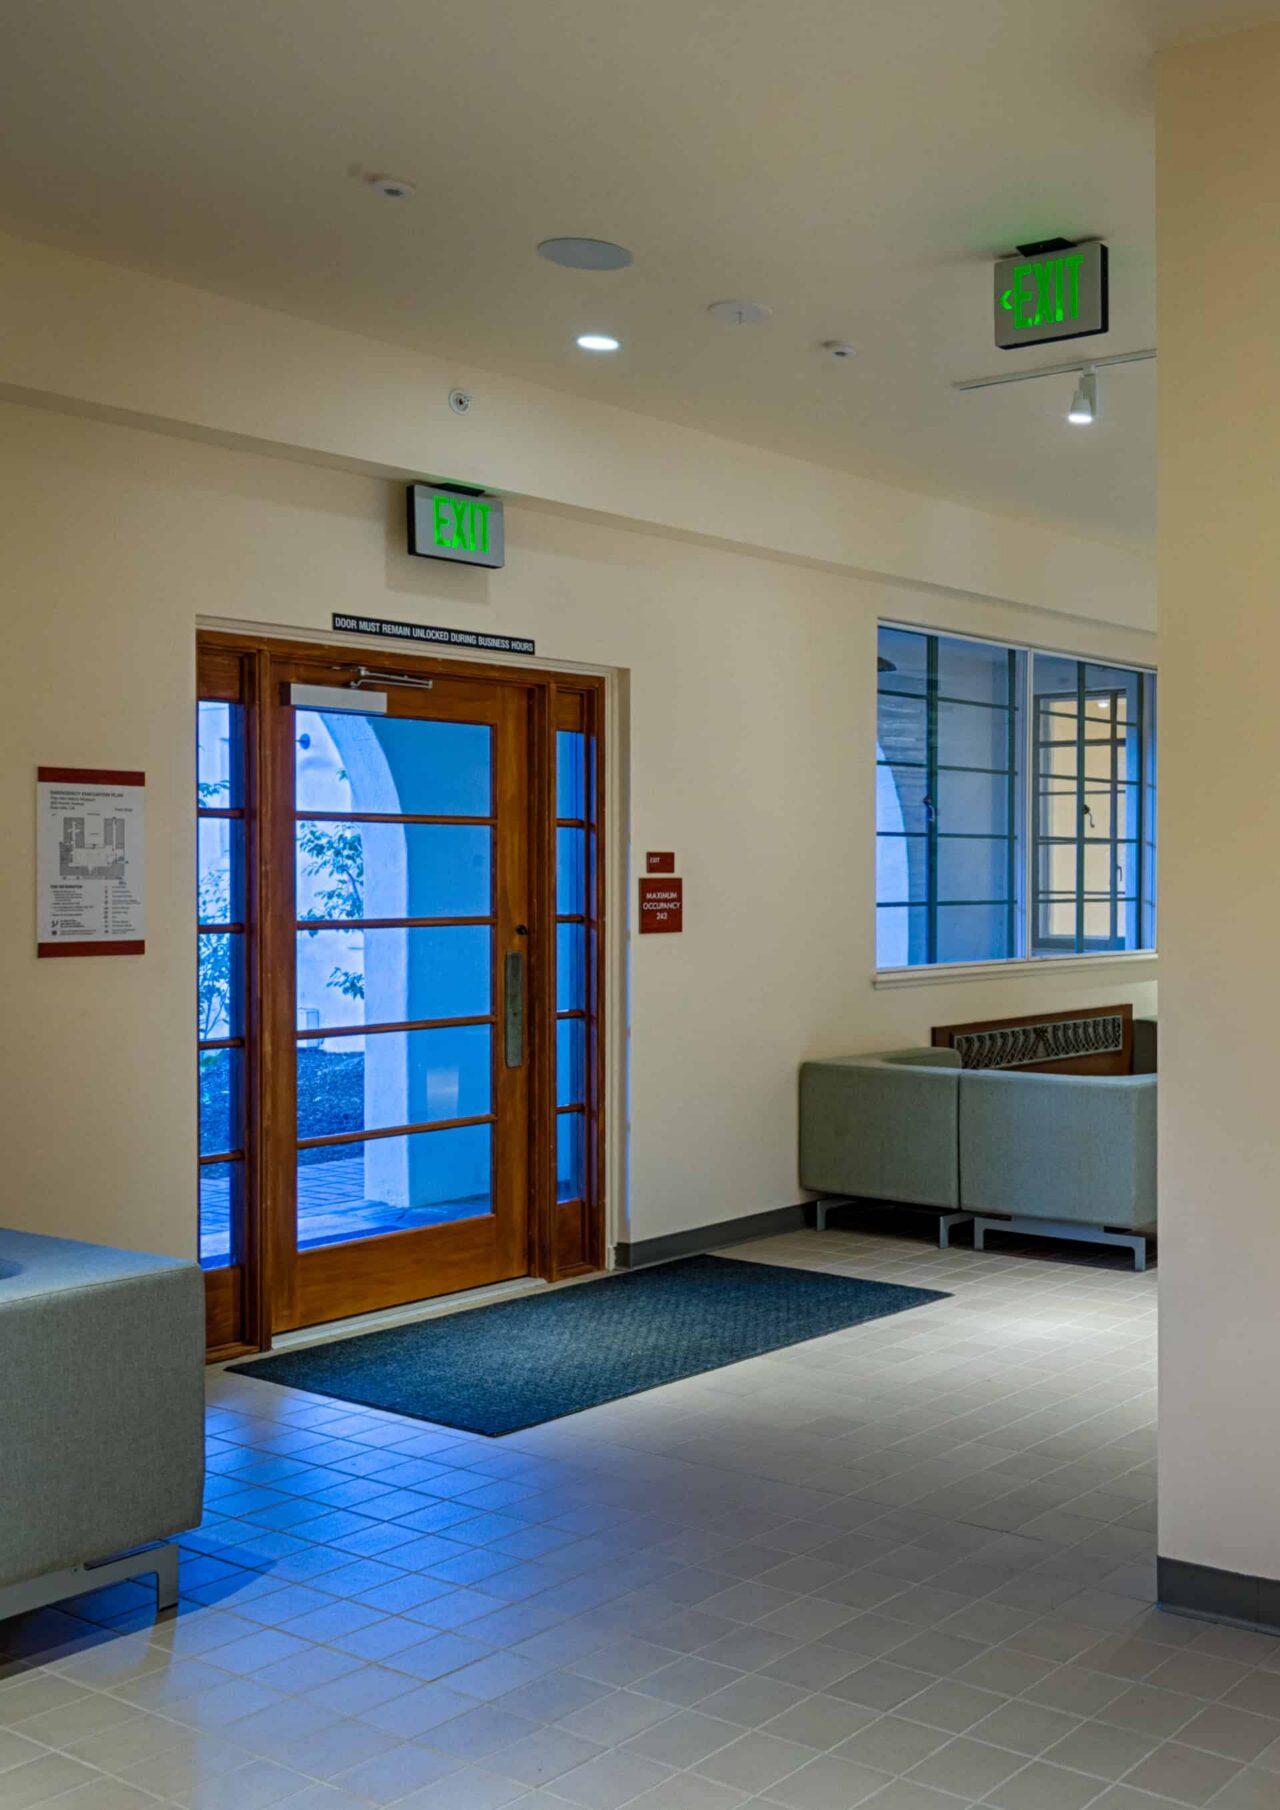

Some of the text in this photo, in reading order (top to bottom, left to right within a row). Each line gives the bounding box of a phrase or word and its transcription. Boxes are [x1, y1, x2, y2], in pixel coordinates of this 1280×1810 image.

[1013, 253, 1085, 330] EXIT
[432, 495, 493, 555] EXIT
[335, 616, 534, 652] DOOR MUST REMAIN UNLOCKED DURING BUSINESS HOURS
[642, 902, 680, 910] OCCUPANCY
